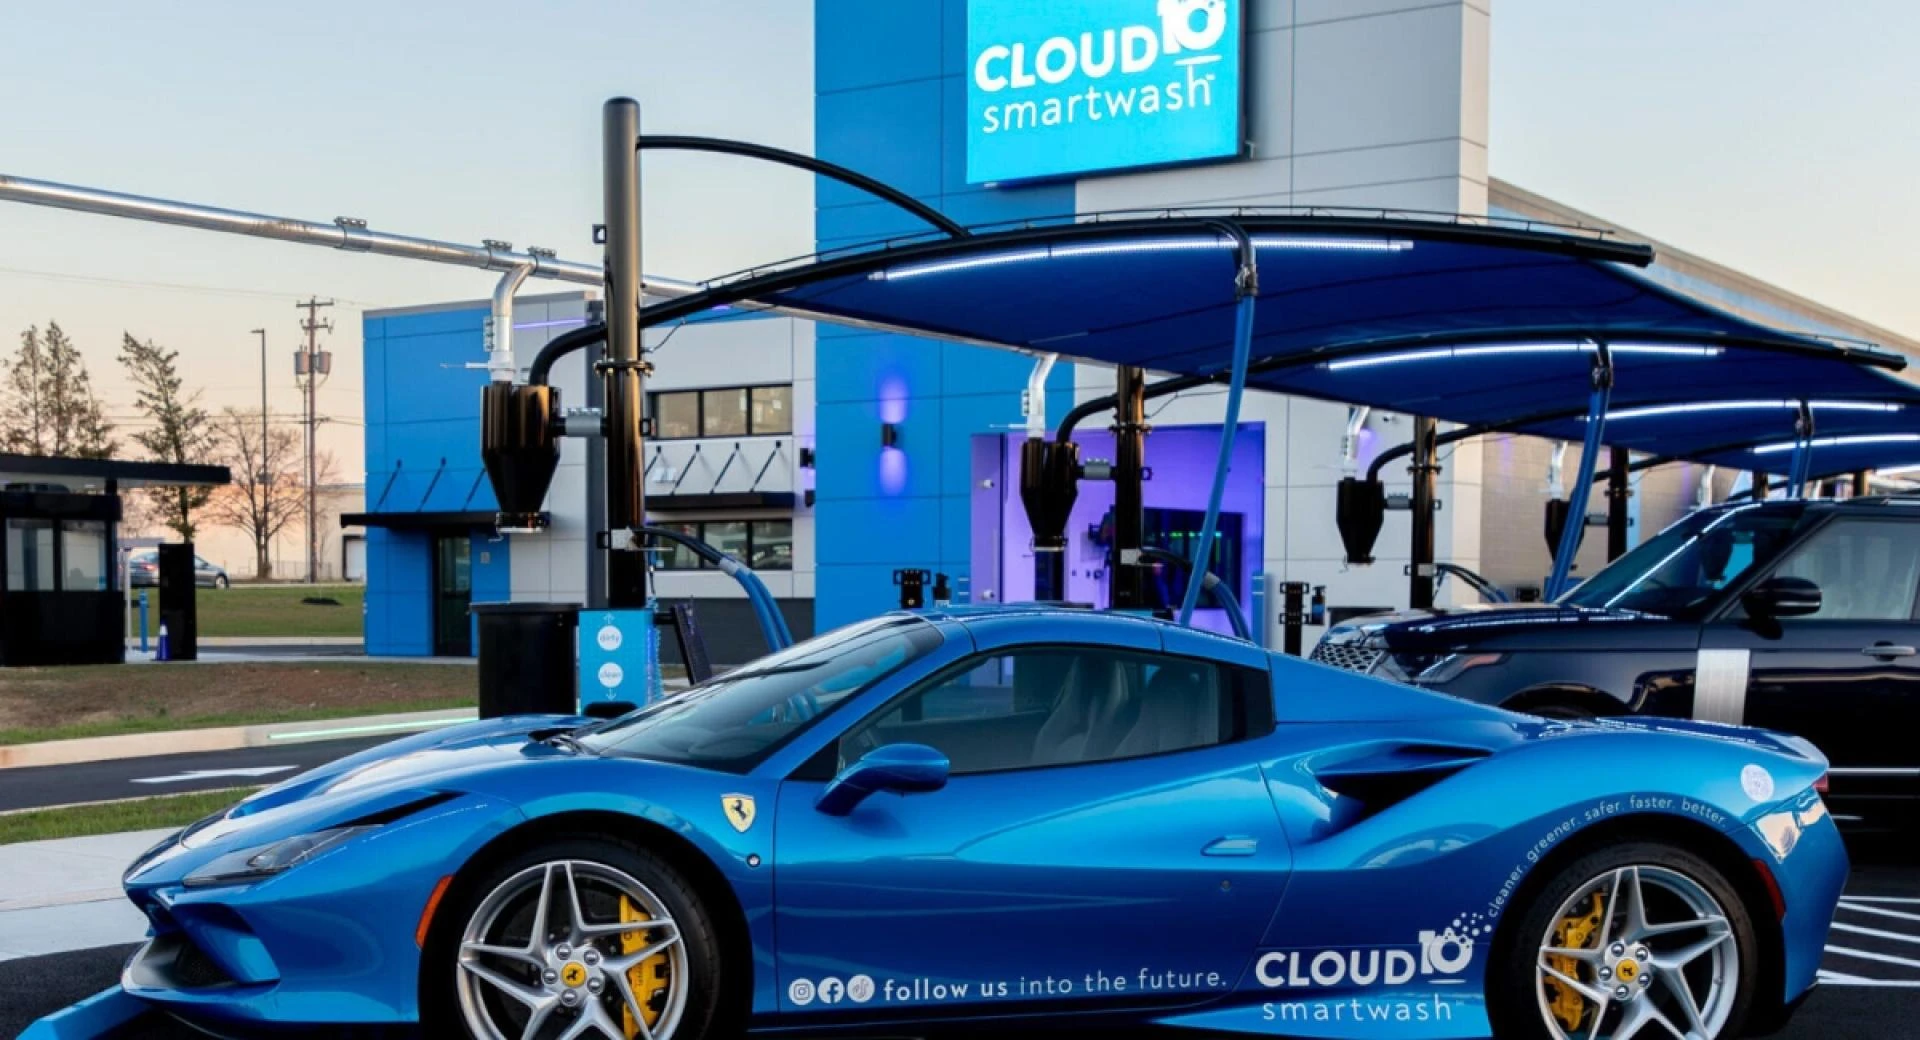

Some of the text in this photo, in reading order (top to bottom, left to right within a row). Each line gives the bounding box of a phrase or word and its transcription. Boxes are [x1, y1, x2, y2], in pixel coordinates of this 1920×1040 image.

[982, 64, 1212, 134] smartwash
[600, 631, 620, 644] dirty
[1681, 797, 1726, 828] better.
[883, 967, 1227, 1001] follow us into the future.
[1263, 993, 1452, 1021] smartwash
